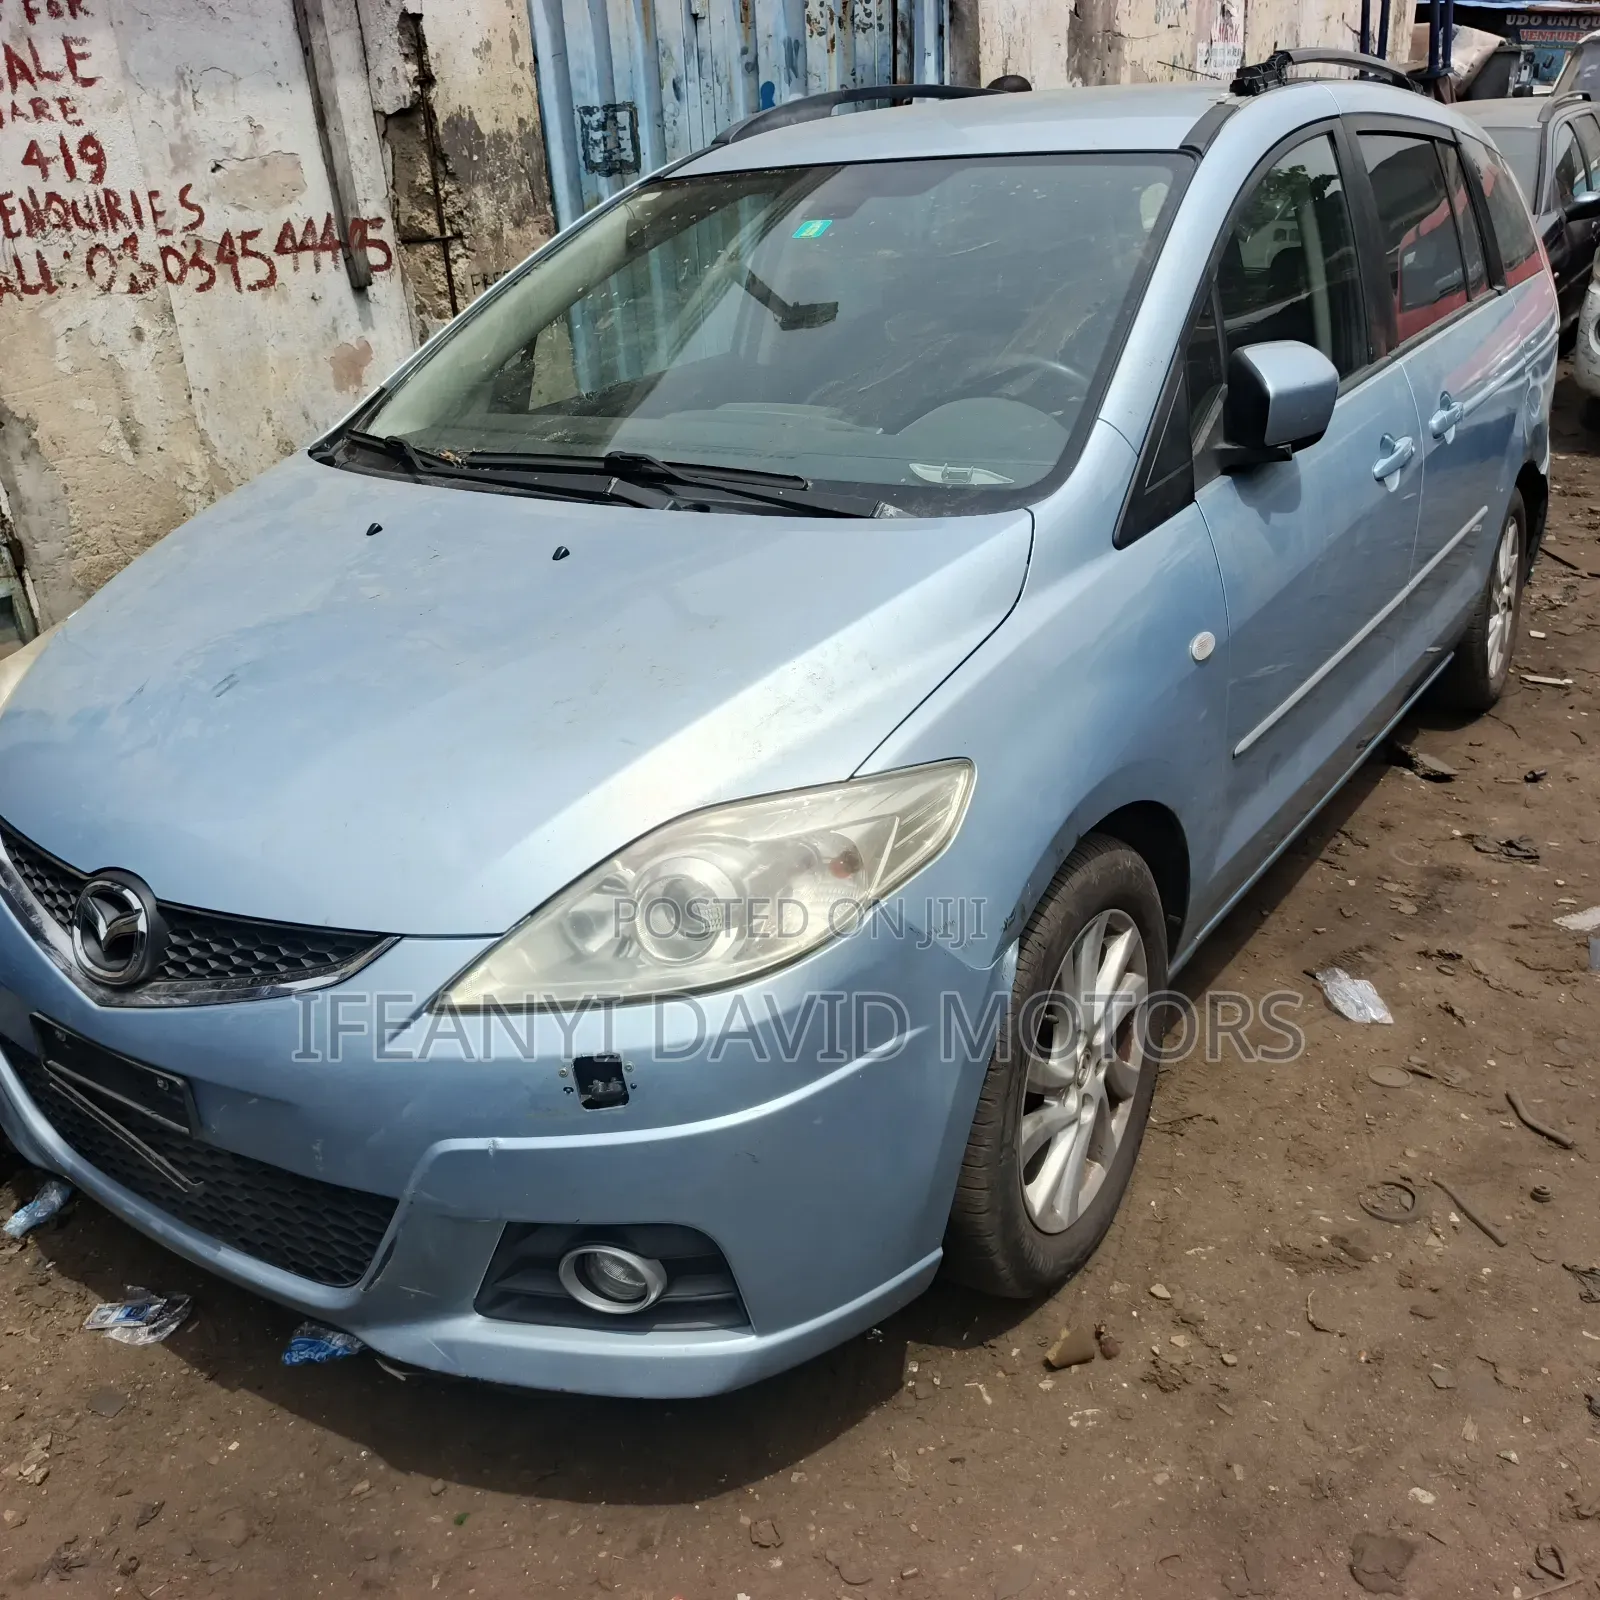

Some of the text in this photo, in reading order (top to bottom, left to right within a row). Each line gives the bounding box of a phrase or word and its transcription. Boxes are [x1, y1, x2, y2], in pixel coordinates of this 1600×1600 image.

[1505, 14, 1542, 26] UDO
[1519, 29, 1591, 43] VENTURE
[0, 33, 102, 95] ALE
[0, 96, 84, 129] ARE
[21, 130, 107, 185] 419
